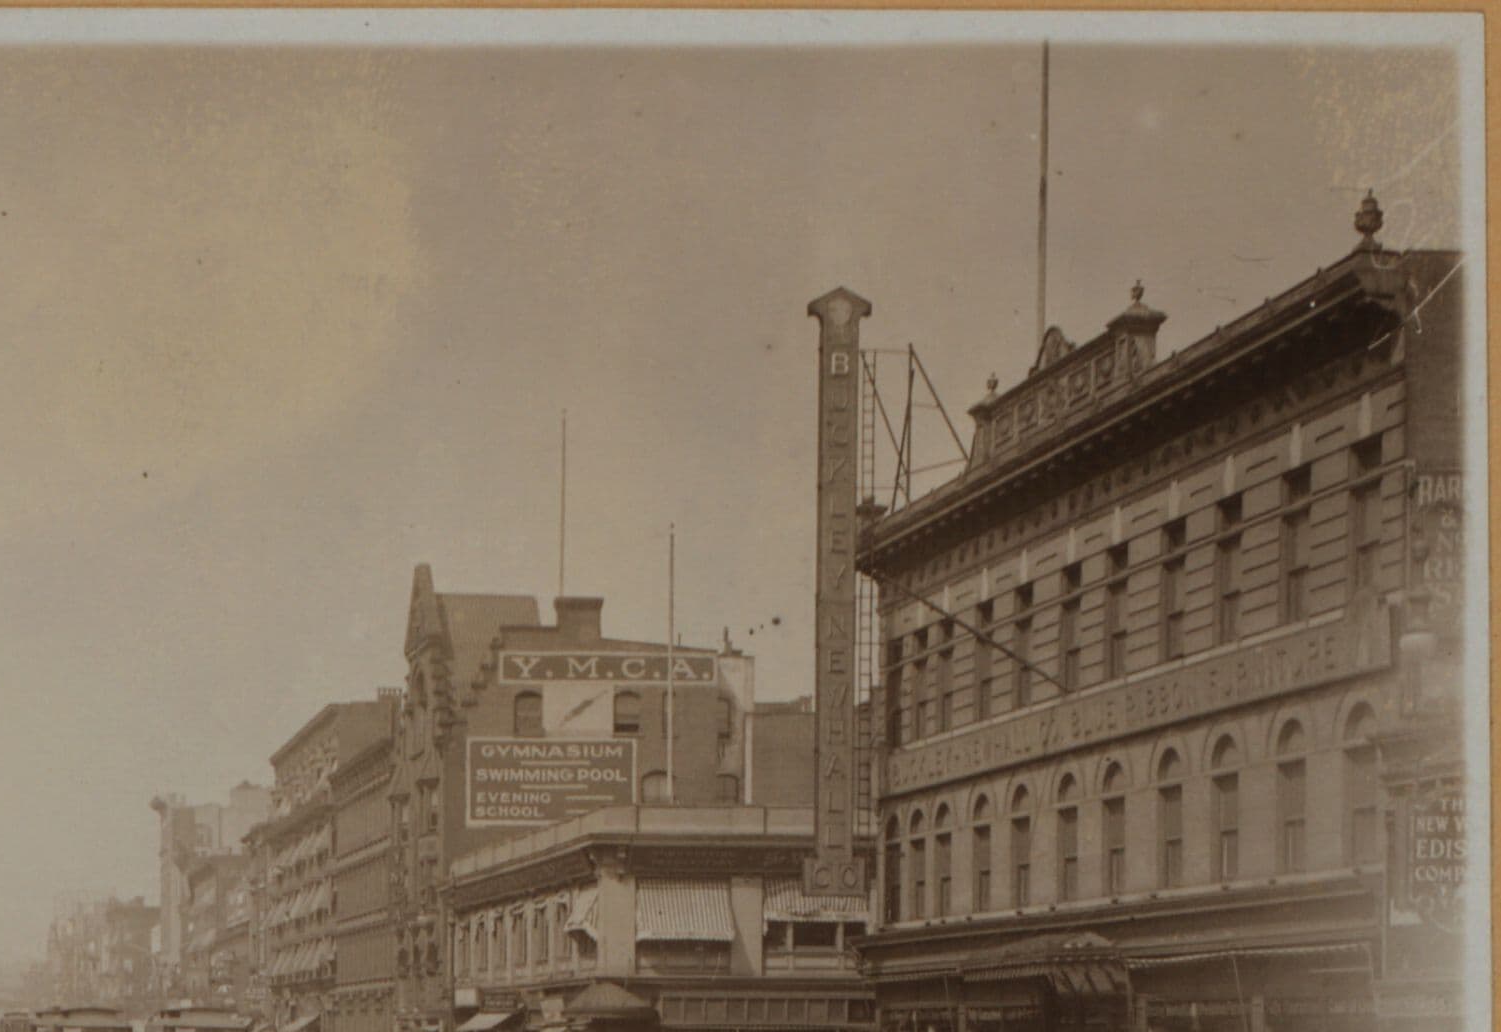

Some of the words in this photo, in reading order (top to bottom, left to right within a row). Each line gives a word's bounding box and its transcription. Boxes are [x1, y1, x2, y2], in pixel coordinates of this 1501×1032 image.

[511, 656, 710, 679] Y.M.C.A.
[481, 744, 623, 758] GYMNASIUM
[475, 767, 574, 782] SWIMMING
[577, 767, 627, 782] POOL
[475, 791, 550, 804] EVENING
[474, 805, 544, 817] SCHOOL
[1415, 815, 1450, 833] NEW
